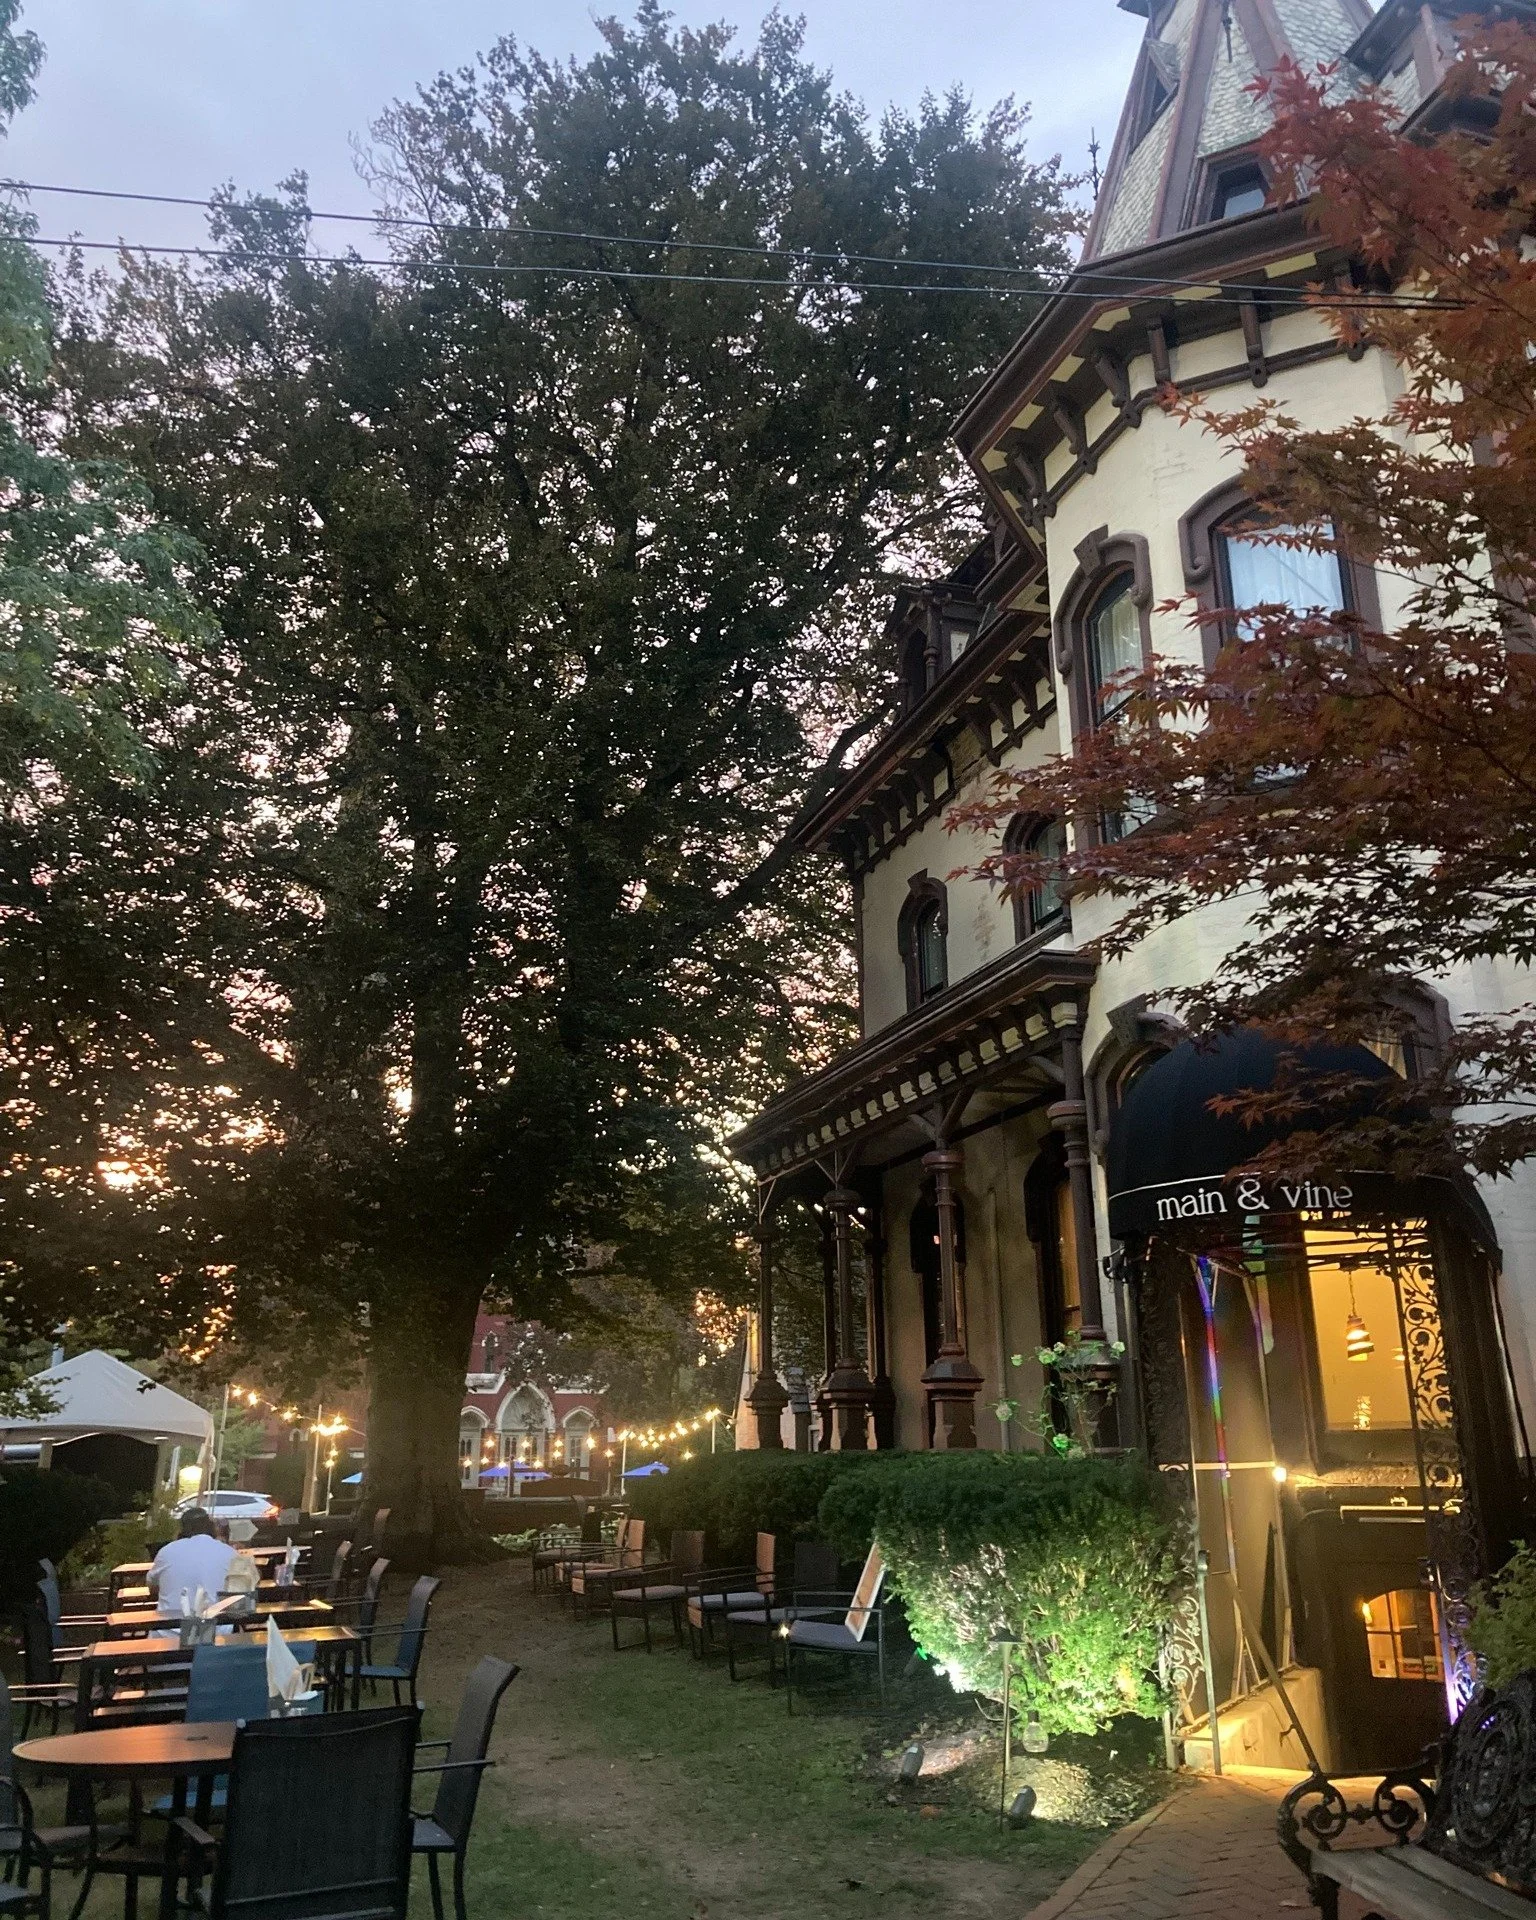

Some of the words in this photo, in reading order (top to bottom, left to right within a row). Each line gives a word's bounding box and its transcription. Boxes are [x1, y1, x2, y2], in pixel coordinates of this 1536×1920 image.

[1156, 1188, 1227, 1221] main
[1237, 1178, 1270, 1210] &
[1281, 1180, 1354, 1209] vine
